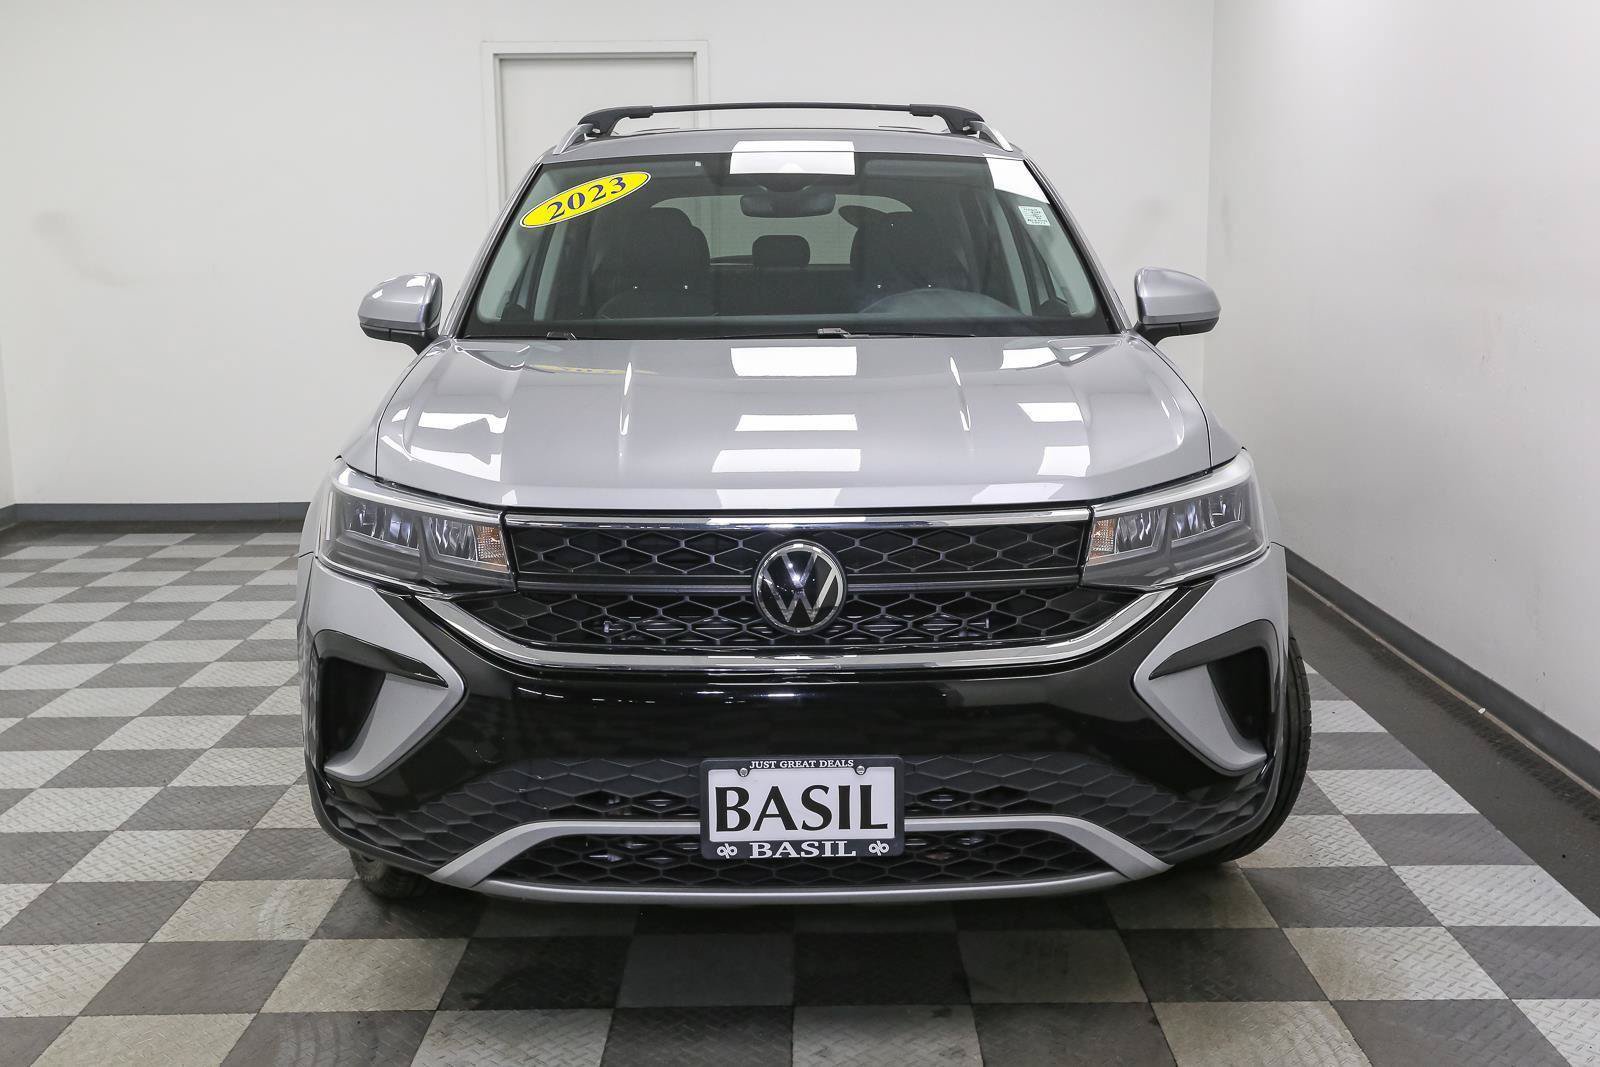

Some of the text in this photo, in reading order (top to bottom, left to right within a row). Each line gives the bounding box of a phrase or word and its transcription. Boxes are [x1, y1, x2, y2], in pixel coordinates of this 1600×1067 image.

[546, 176, 627, 221] 2023
[749, 759, 854, 769] JUST GREAT DEALS
[714, 784, 889, 833] BASIL
[749, 840, 857, 859] BASIL
